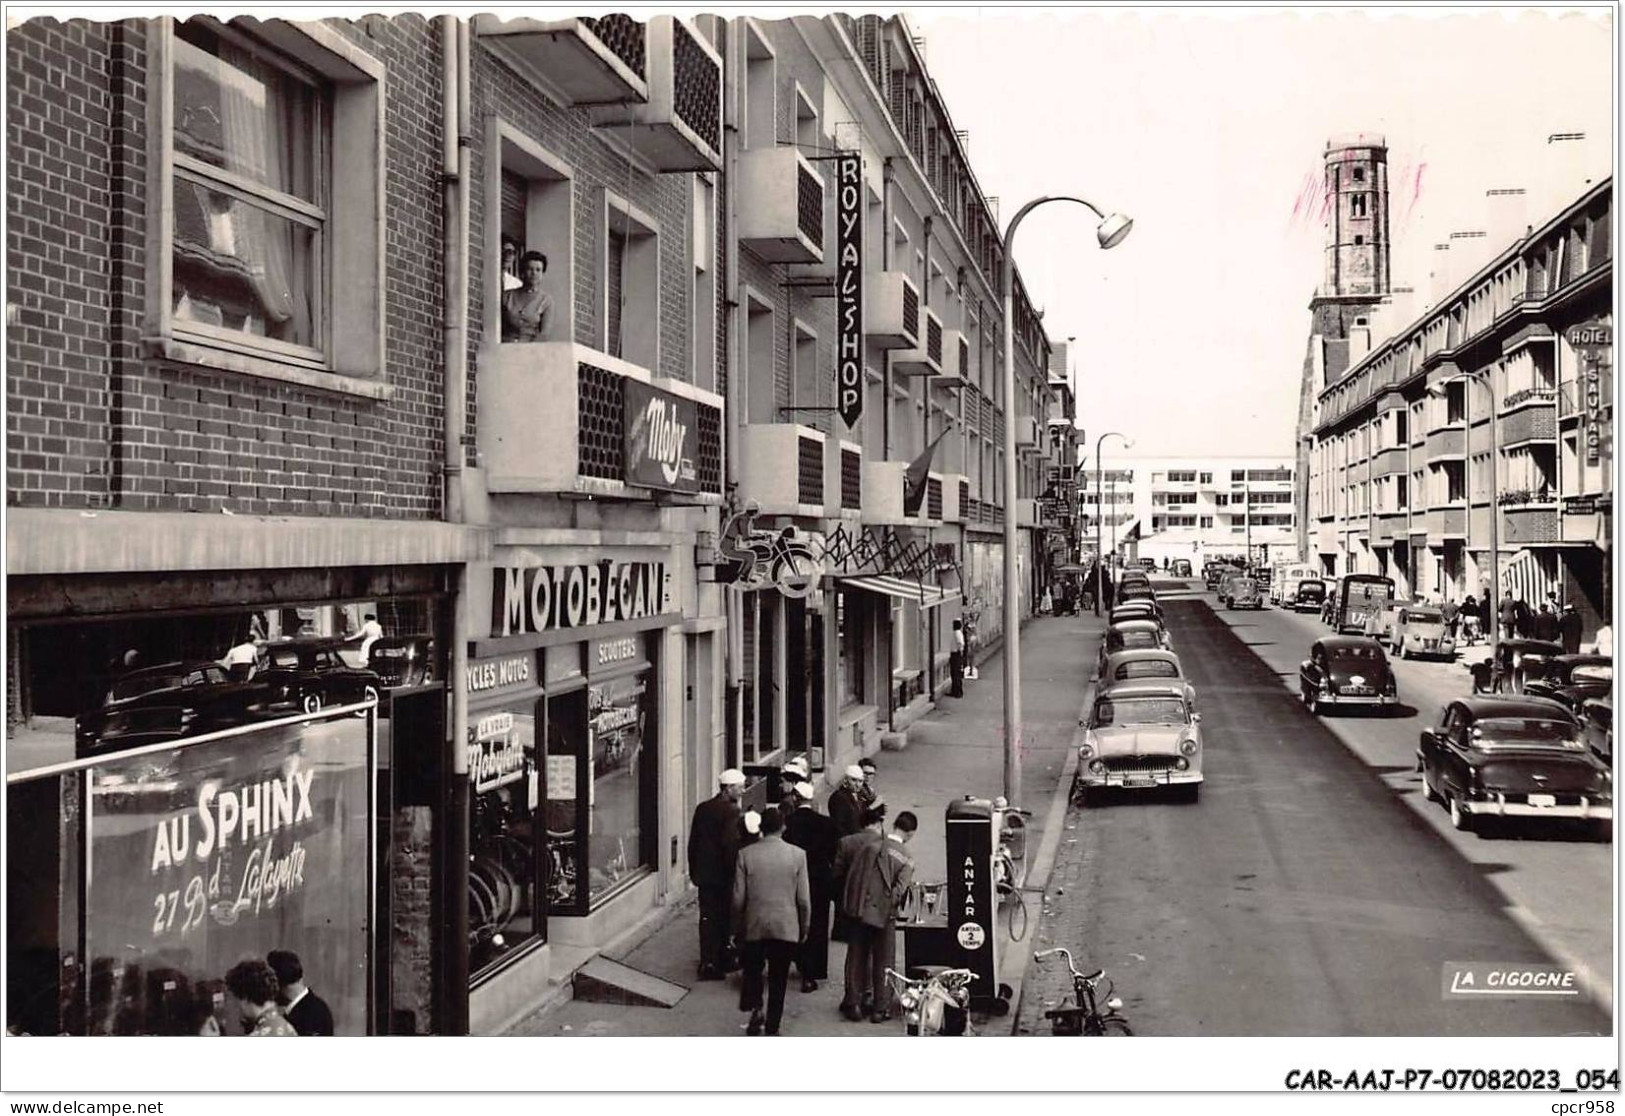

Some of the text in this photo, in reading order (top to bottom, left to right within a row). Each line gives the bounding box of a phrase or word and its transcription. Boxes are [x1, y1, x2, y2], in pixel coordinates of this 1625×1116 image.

[1572, 327, 1612, 344] HOTEL
[646, 396, 686, 484] Moby
[1587, 369, 1599, 458] SAUVAGE
[467, 656, 528, 691] YCLES MOTOS
[599, 637, 636, 664] SCOOTERS
[151, 769, 313, 872] AU SPHINX
[153, 889, 181, 935] 27
[231, 838, 306, 916] Lafayette
[964, 856, 975, 916] ANTAR
[968, 932, 974, 940] 2
